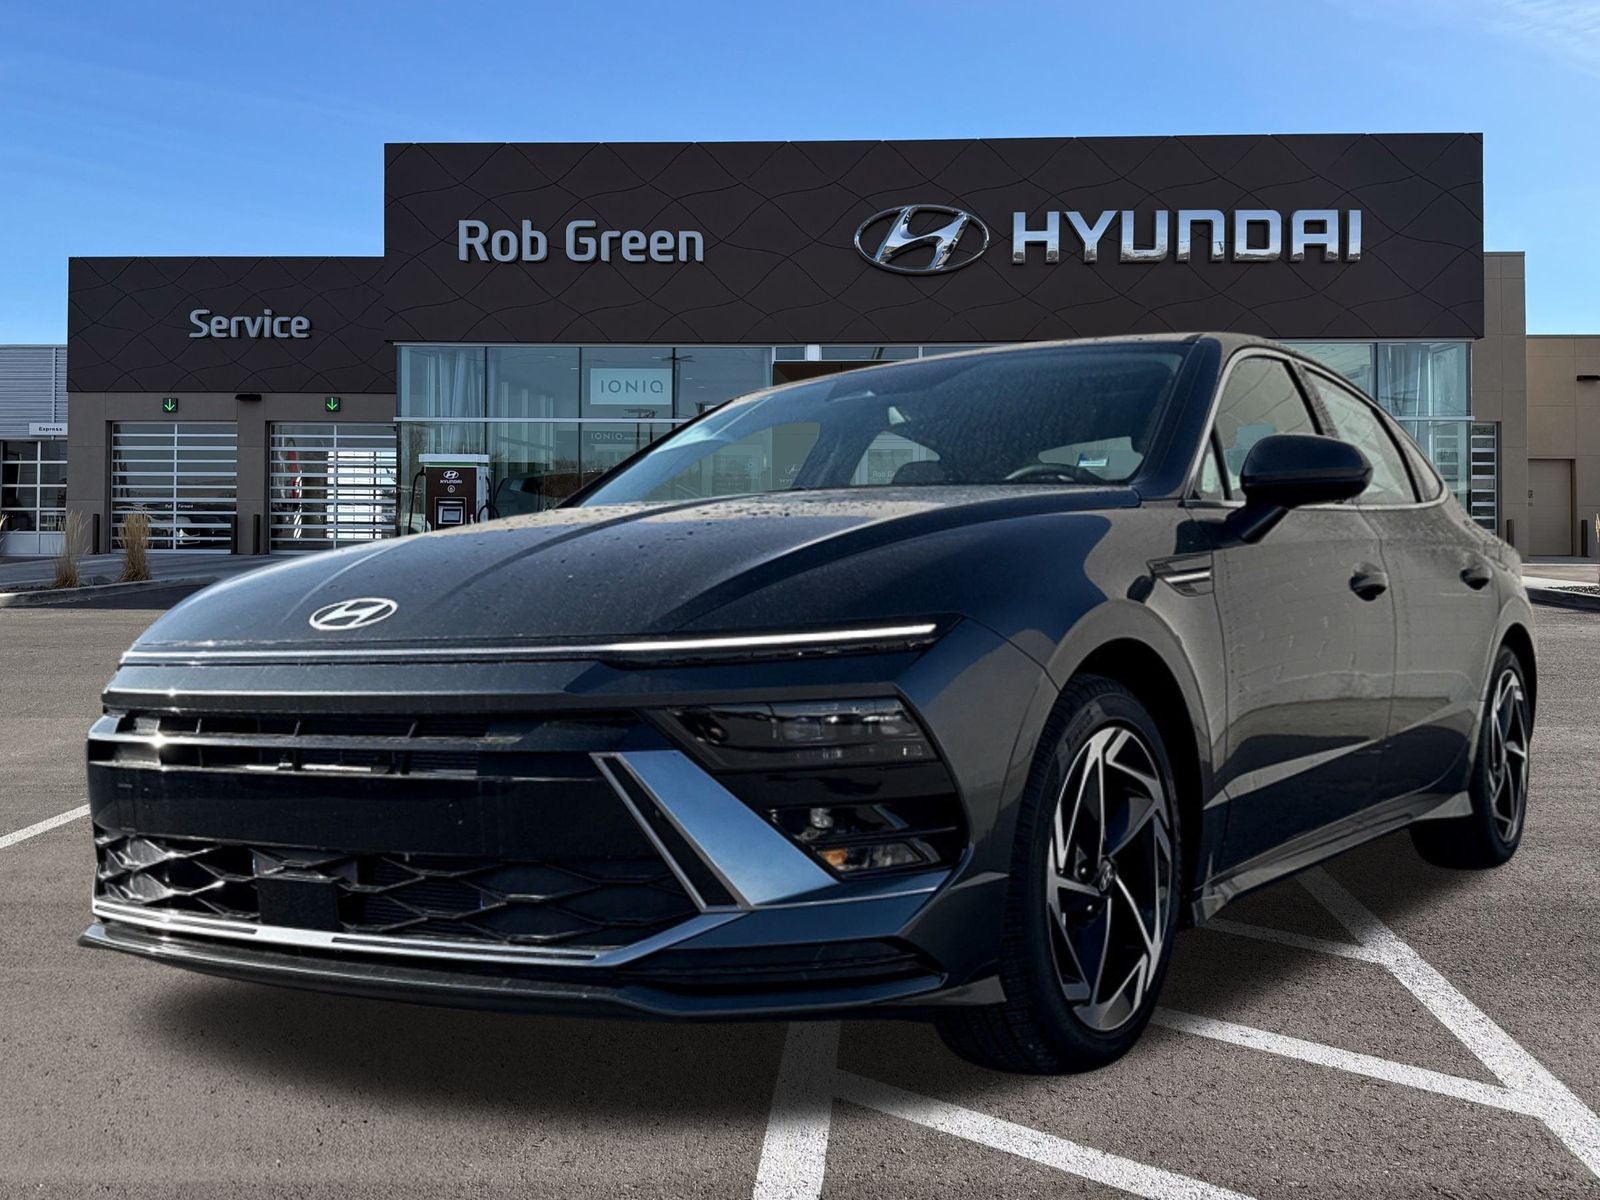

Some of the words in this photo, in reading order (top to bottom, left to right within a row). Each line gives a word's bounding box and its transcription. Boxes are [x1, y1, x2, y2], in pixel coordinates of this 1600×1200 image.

[458, 219, 549, 262] Rob
[565, 219, 704, 262] Green
[1012, 209, 1362, 264] HYUNDAI
[189, 308, 311, 338] Service
[600, 379, 664, 393] IONIQ
